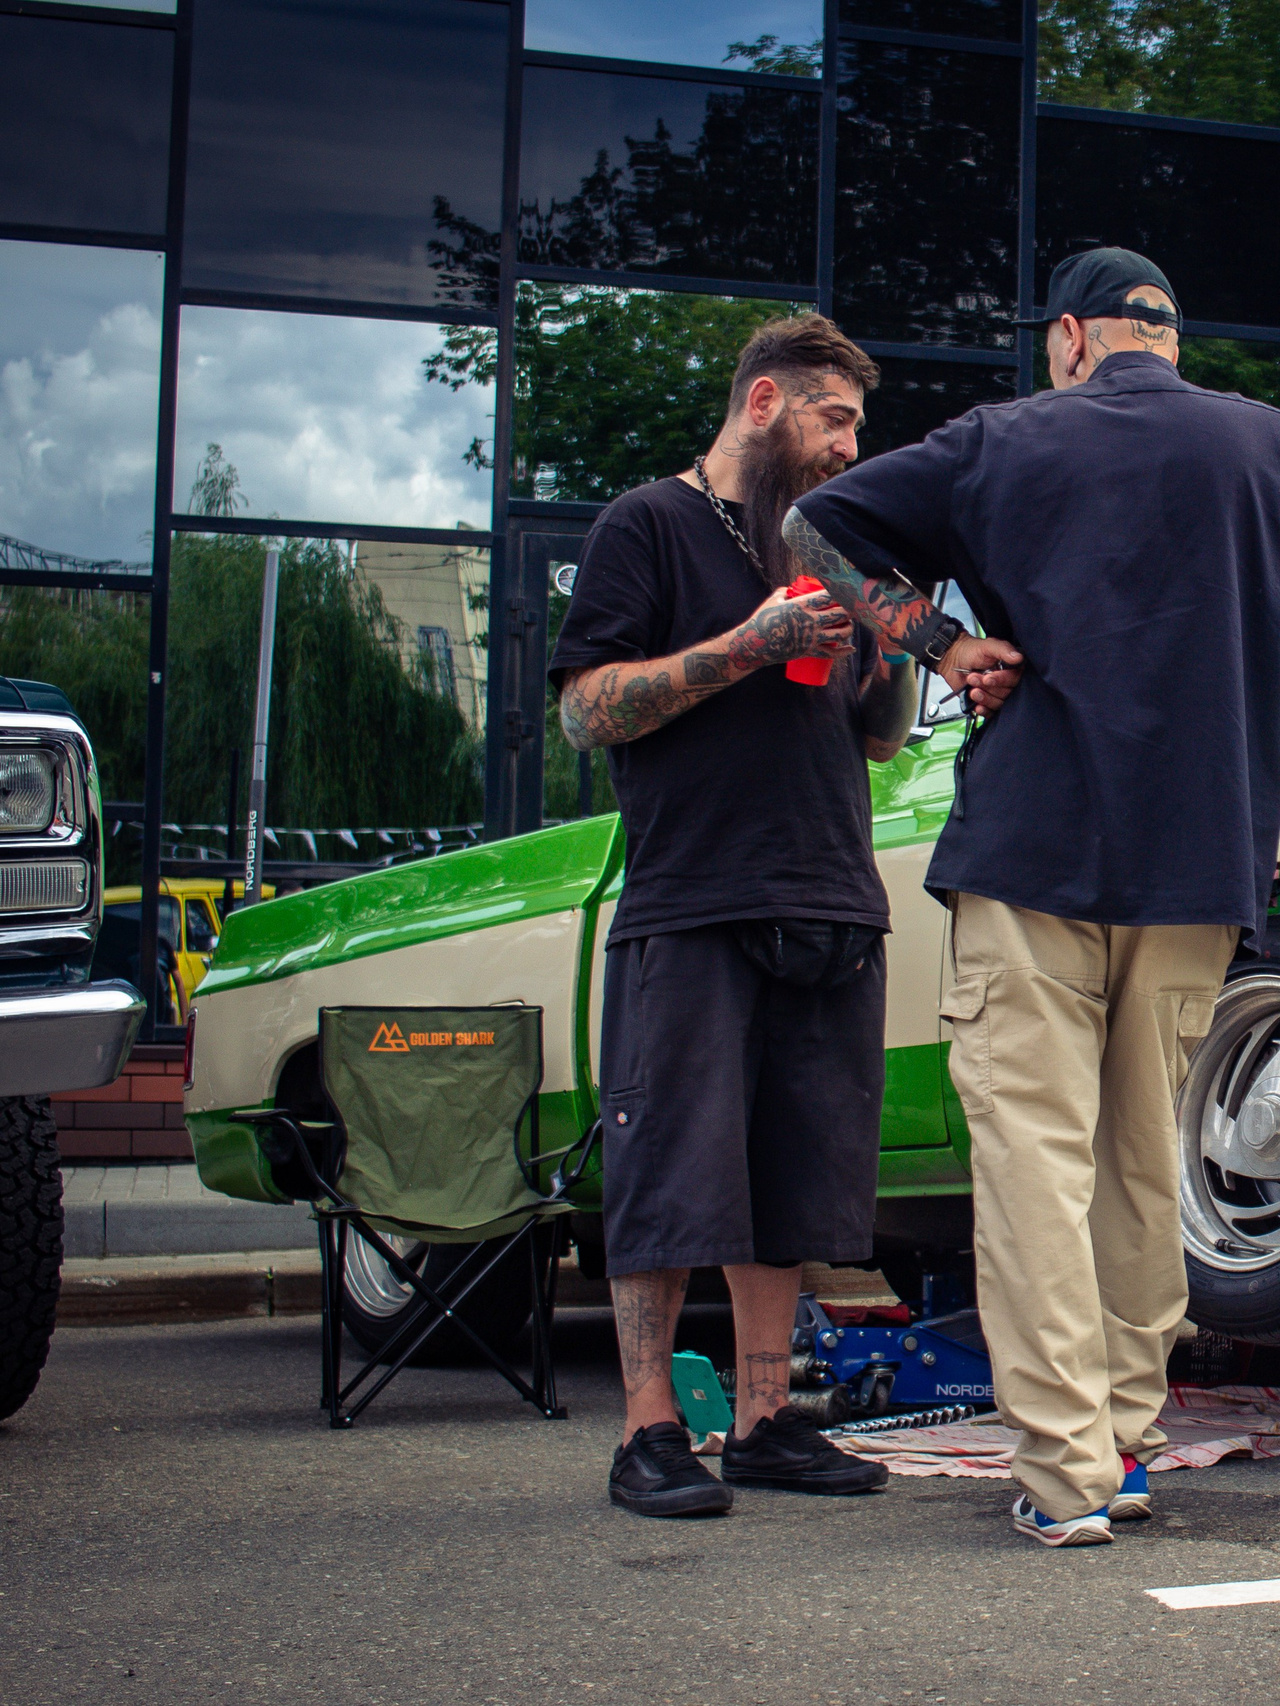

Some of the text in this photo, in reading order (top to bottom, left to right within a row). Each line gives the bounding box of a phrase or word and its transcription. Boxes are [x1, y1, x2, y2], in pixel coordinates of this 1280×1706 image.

[245, 810, 257, 891] NORDBERG
[409, 1031, 495, 1046] GOLDEN SHARK
